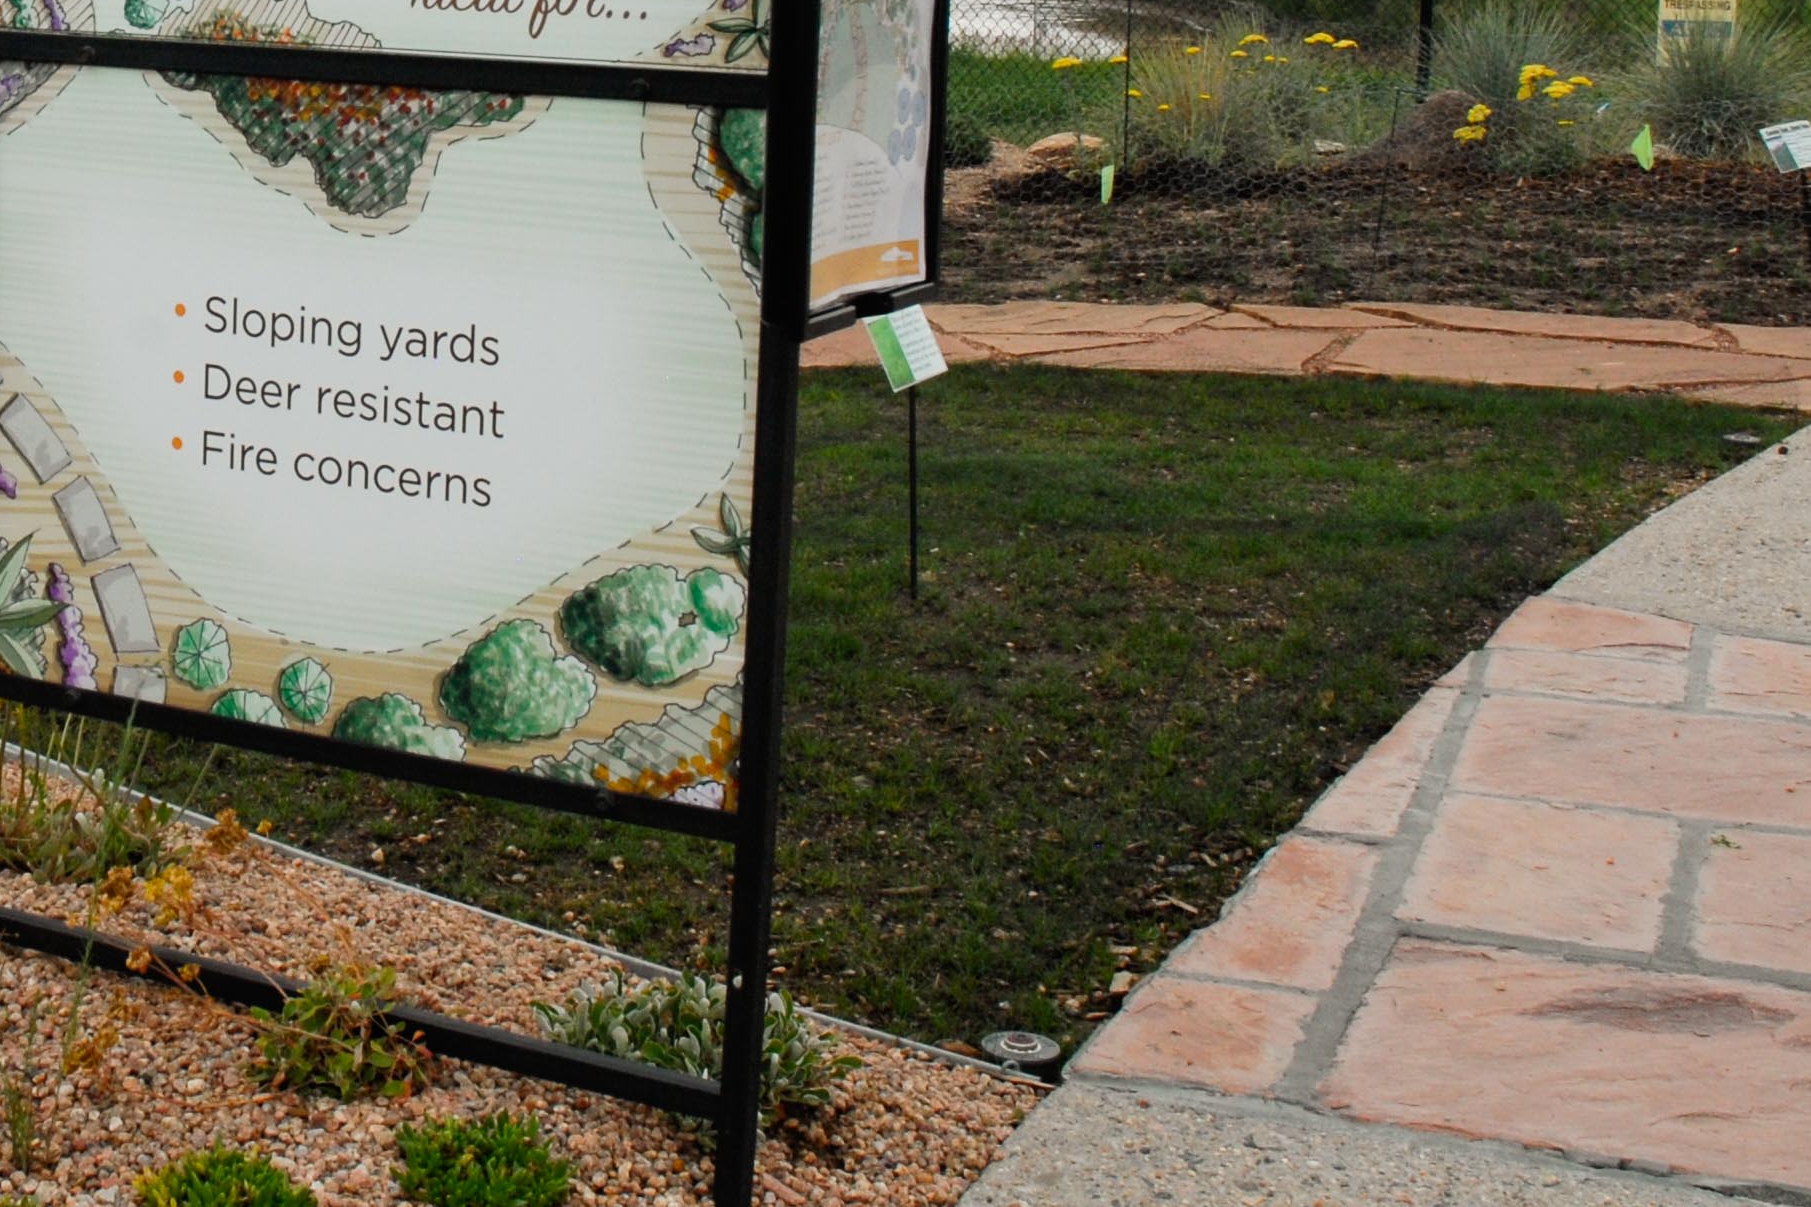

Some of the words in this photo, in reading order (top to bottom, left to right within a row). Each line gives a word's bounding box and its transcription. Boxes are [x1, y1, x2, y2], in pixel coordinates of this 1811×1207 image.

[204, 295, 362, 358] Sloping
[379, 323, 500, 367] yards
[204, 363, 301, 411] Deer
[317, 385, 505, 439] resistant
[202, 430, 278, 476] Fire
[293, 452, 491, 508] concerns
